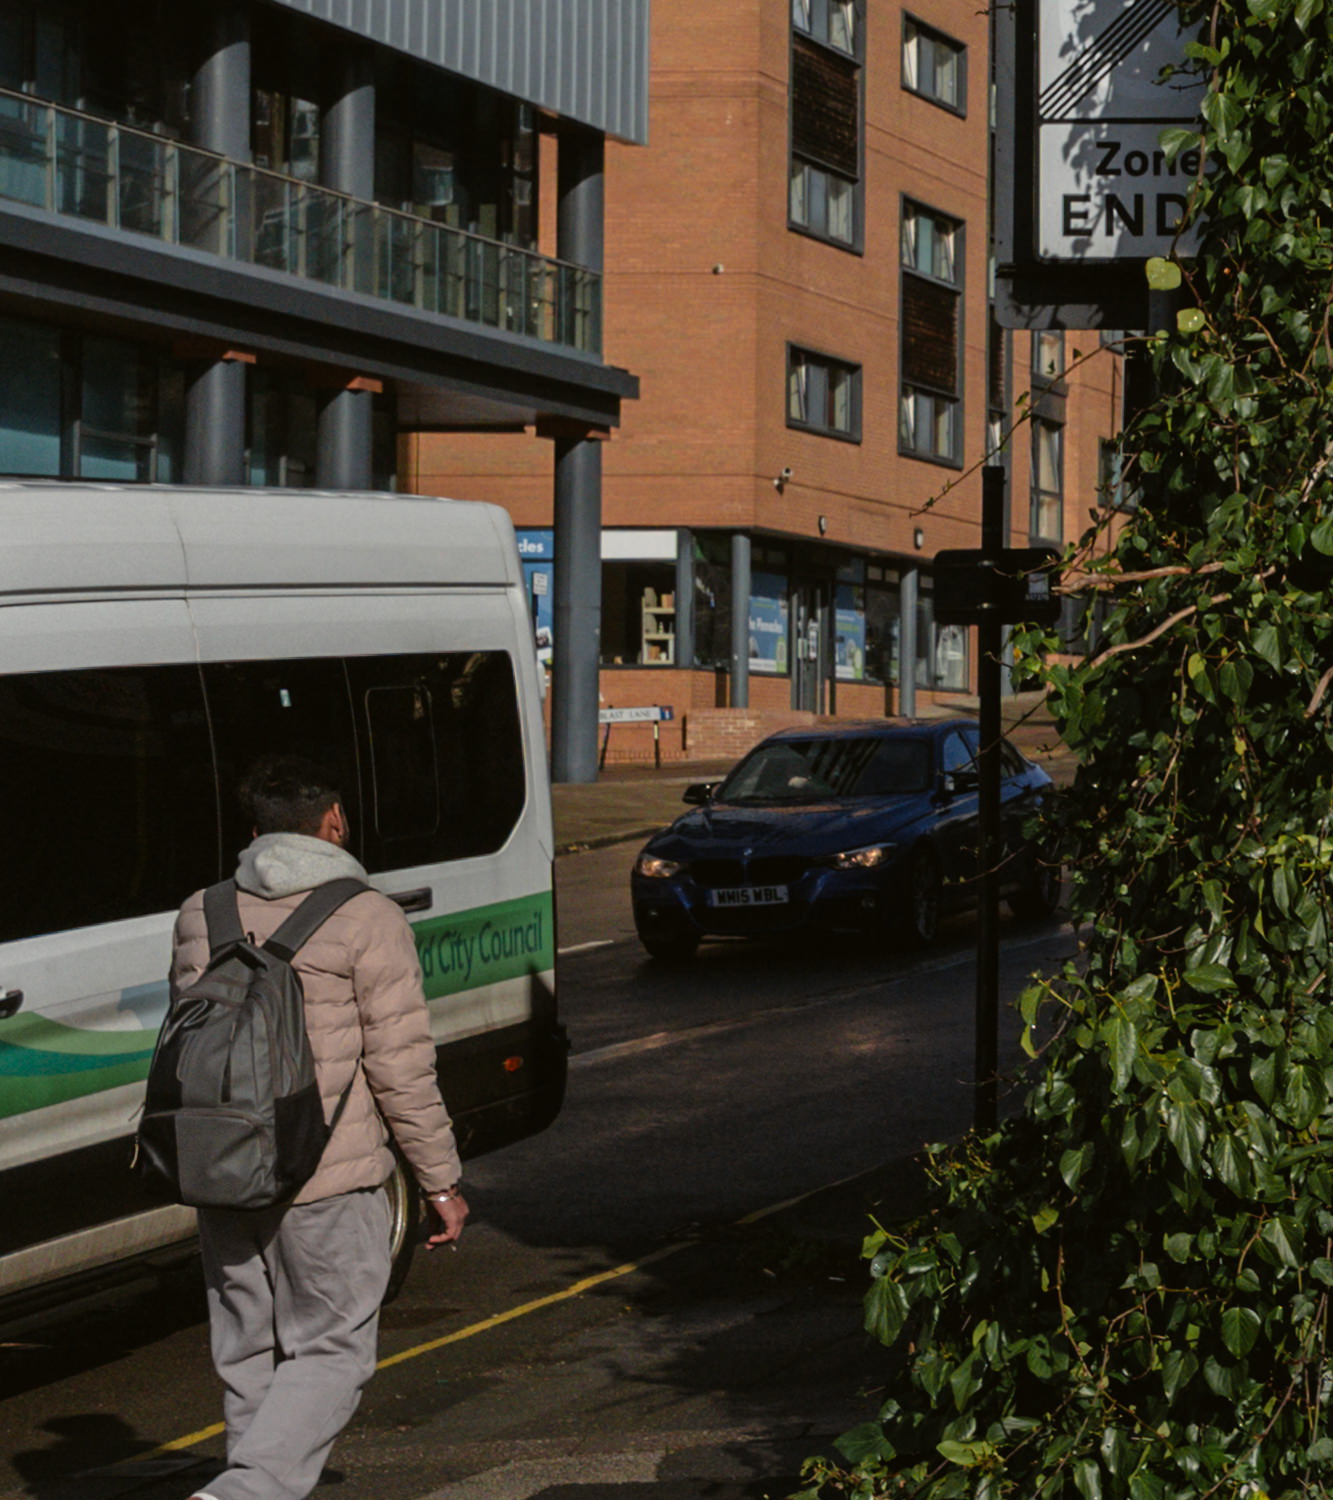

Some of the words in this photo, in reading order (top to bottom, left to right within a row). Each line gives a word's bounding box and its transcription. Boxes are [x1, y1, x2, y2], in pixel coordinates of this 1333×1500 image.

[1095, 141, 1202, 176] Zone
[1062, 193, 1206, 238] END
[437, 929, 474, 982] City
[479, 911, 543, 964] Council
